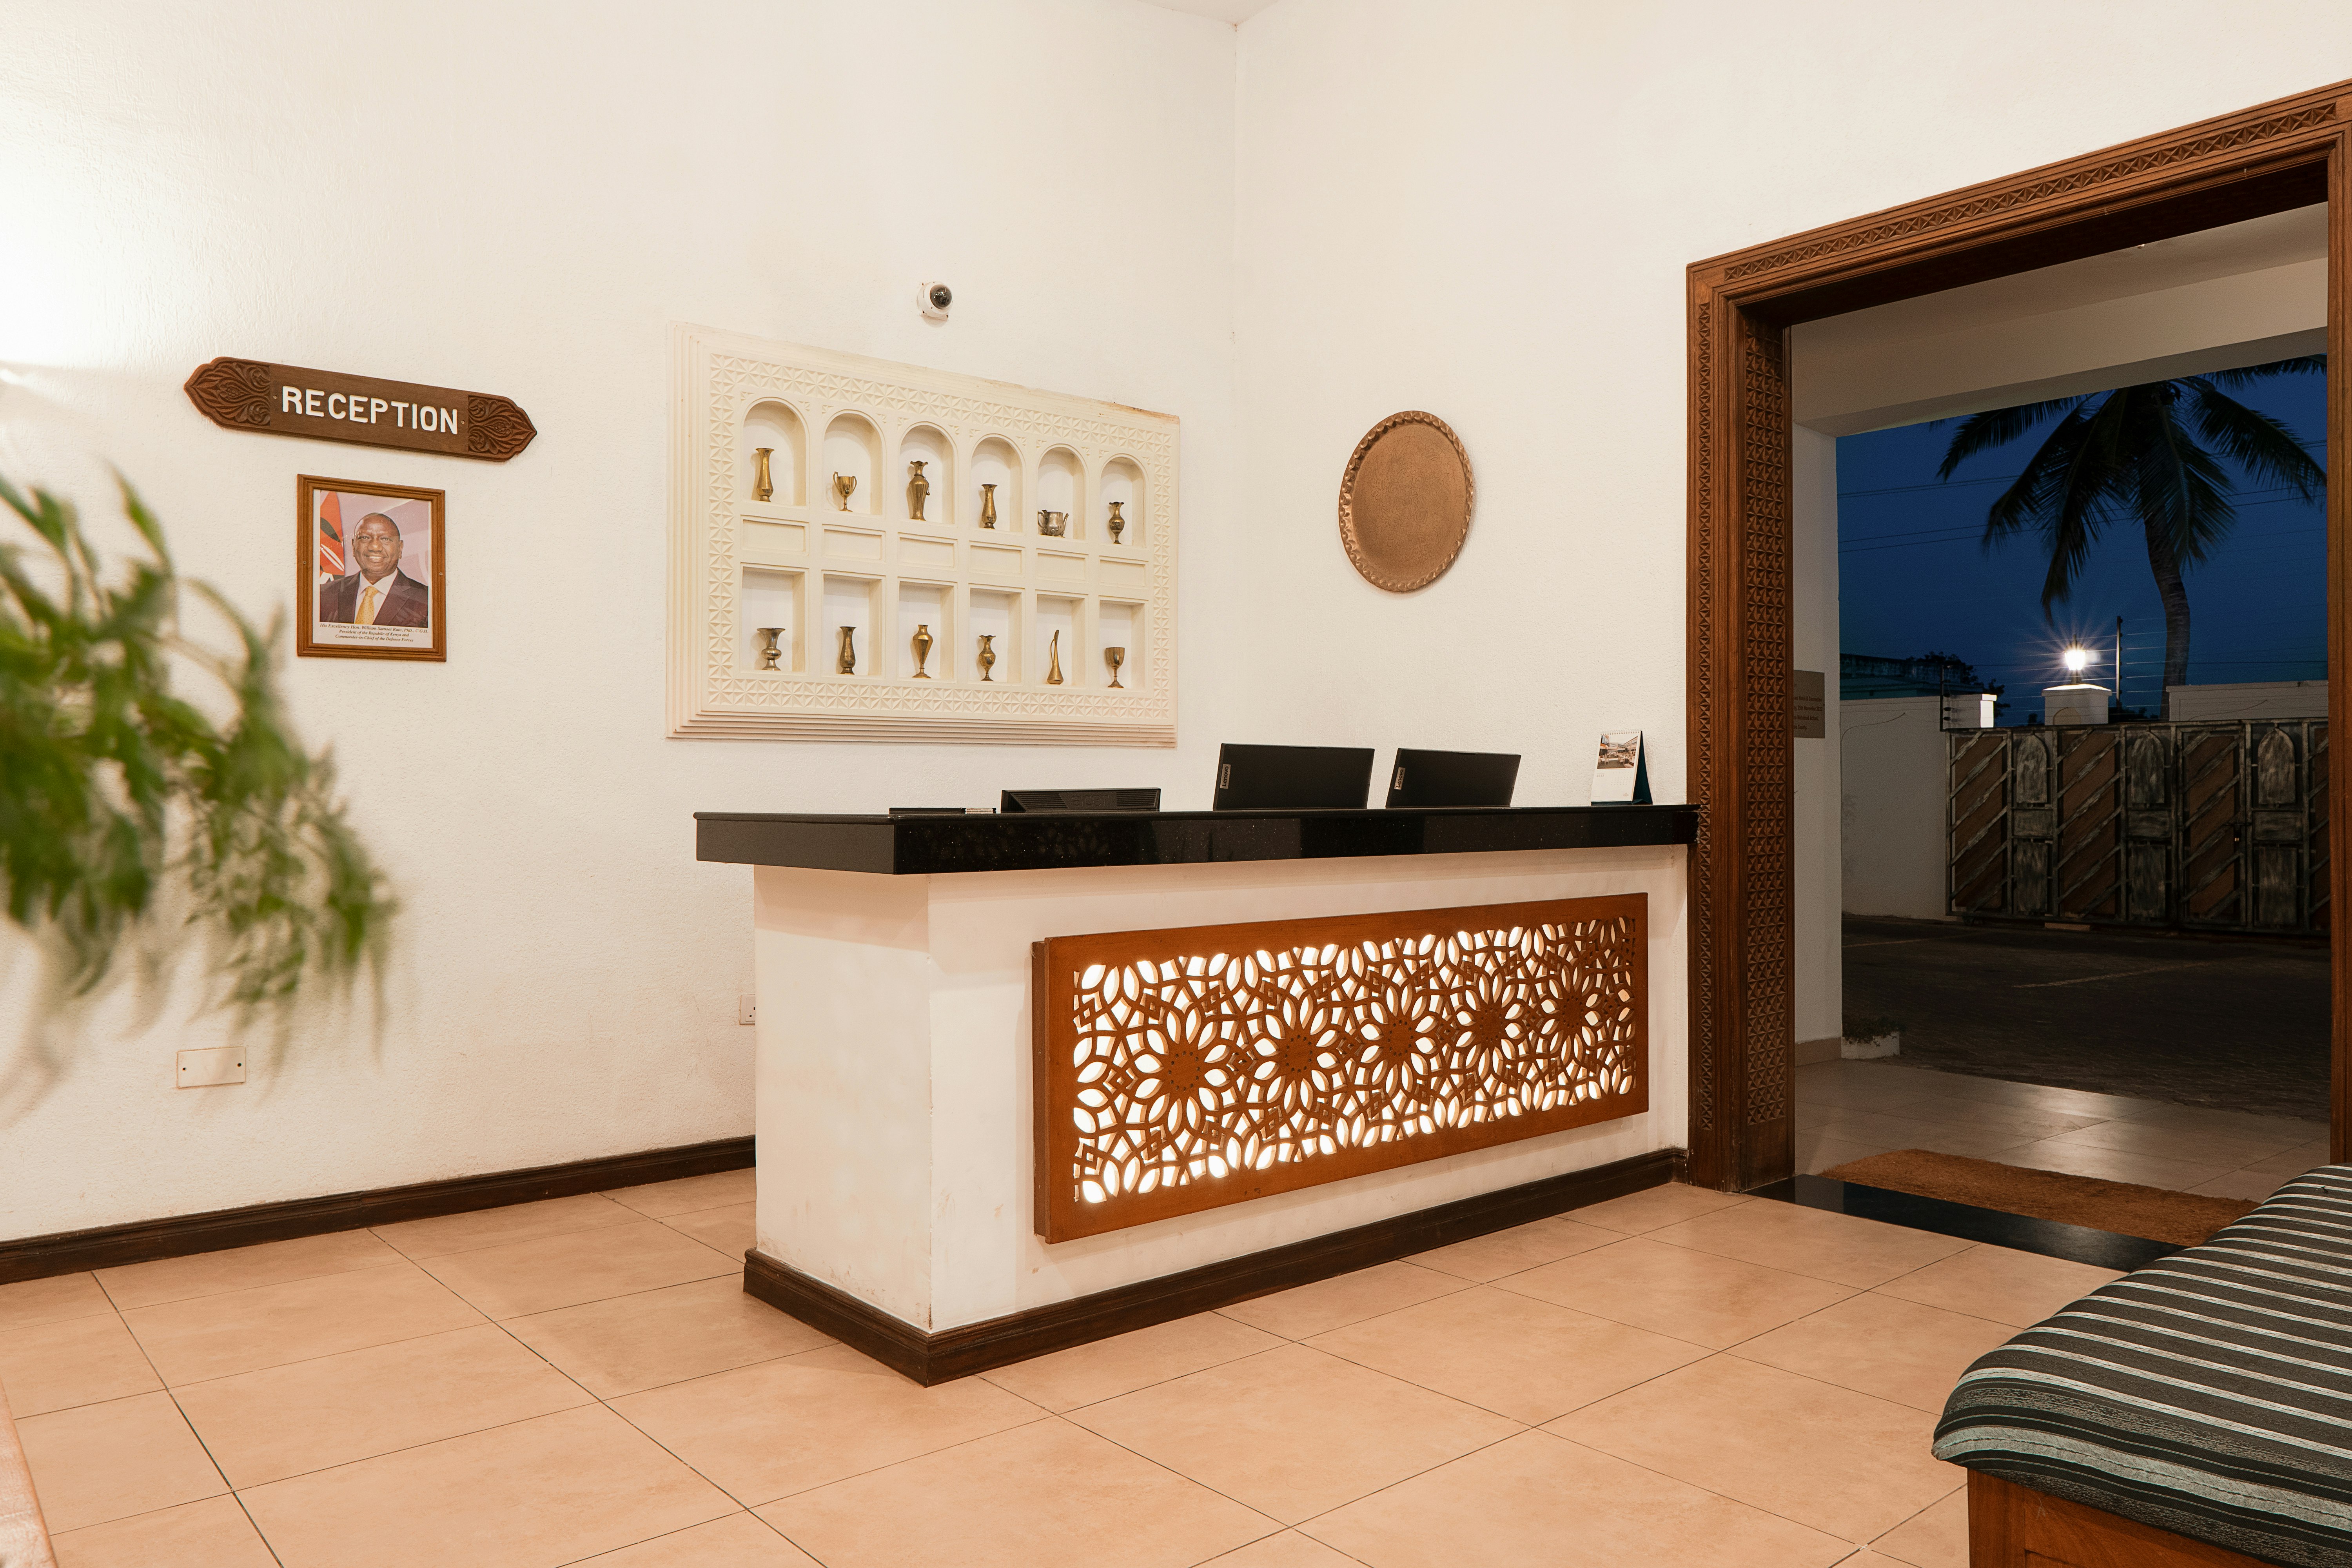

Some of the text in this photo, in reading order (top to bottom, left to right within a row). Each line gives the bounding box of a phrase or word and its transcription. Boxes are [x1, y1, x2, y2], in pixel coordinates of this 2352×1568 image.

[282, 385, 459, 435] RECEPTION
[1396, 769, 1404, 788] Lenovo
[1072, 795, 1109, 807] acer
